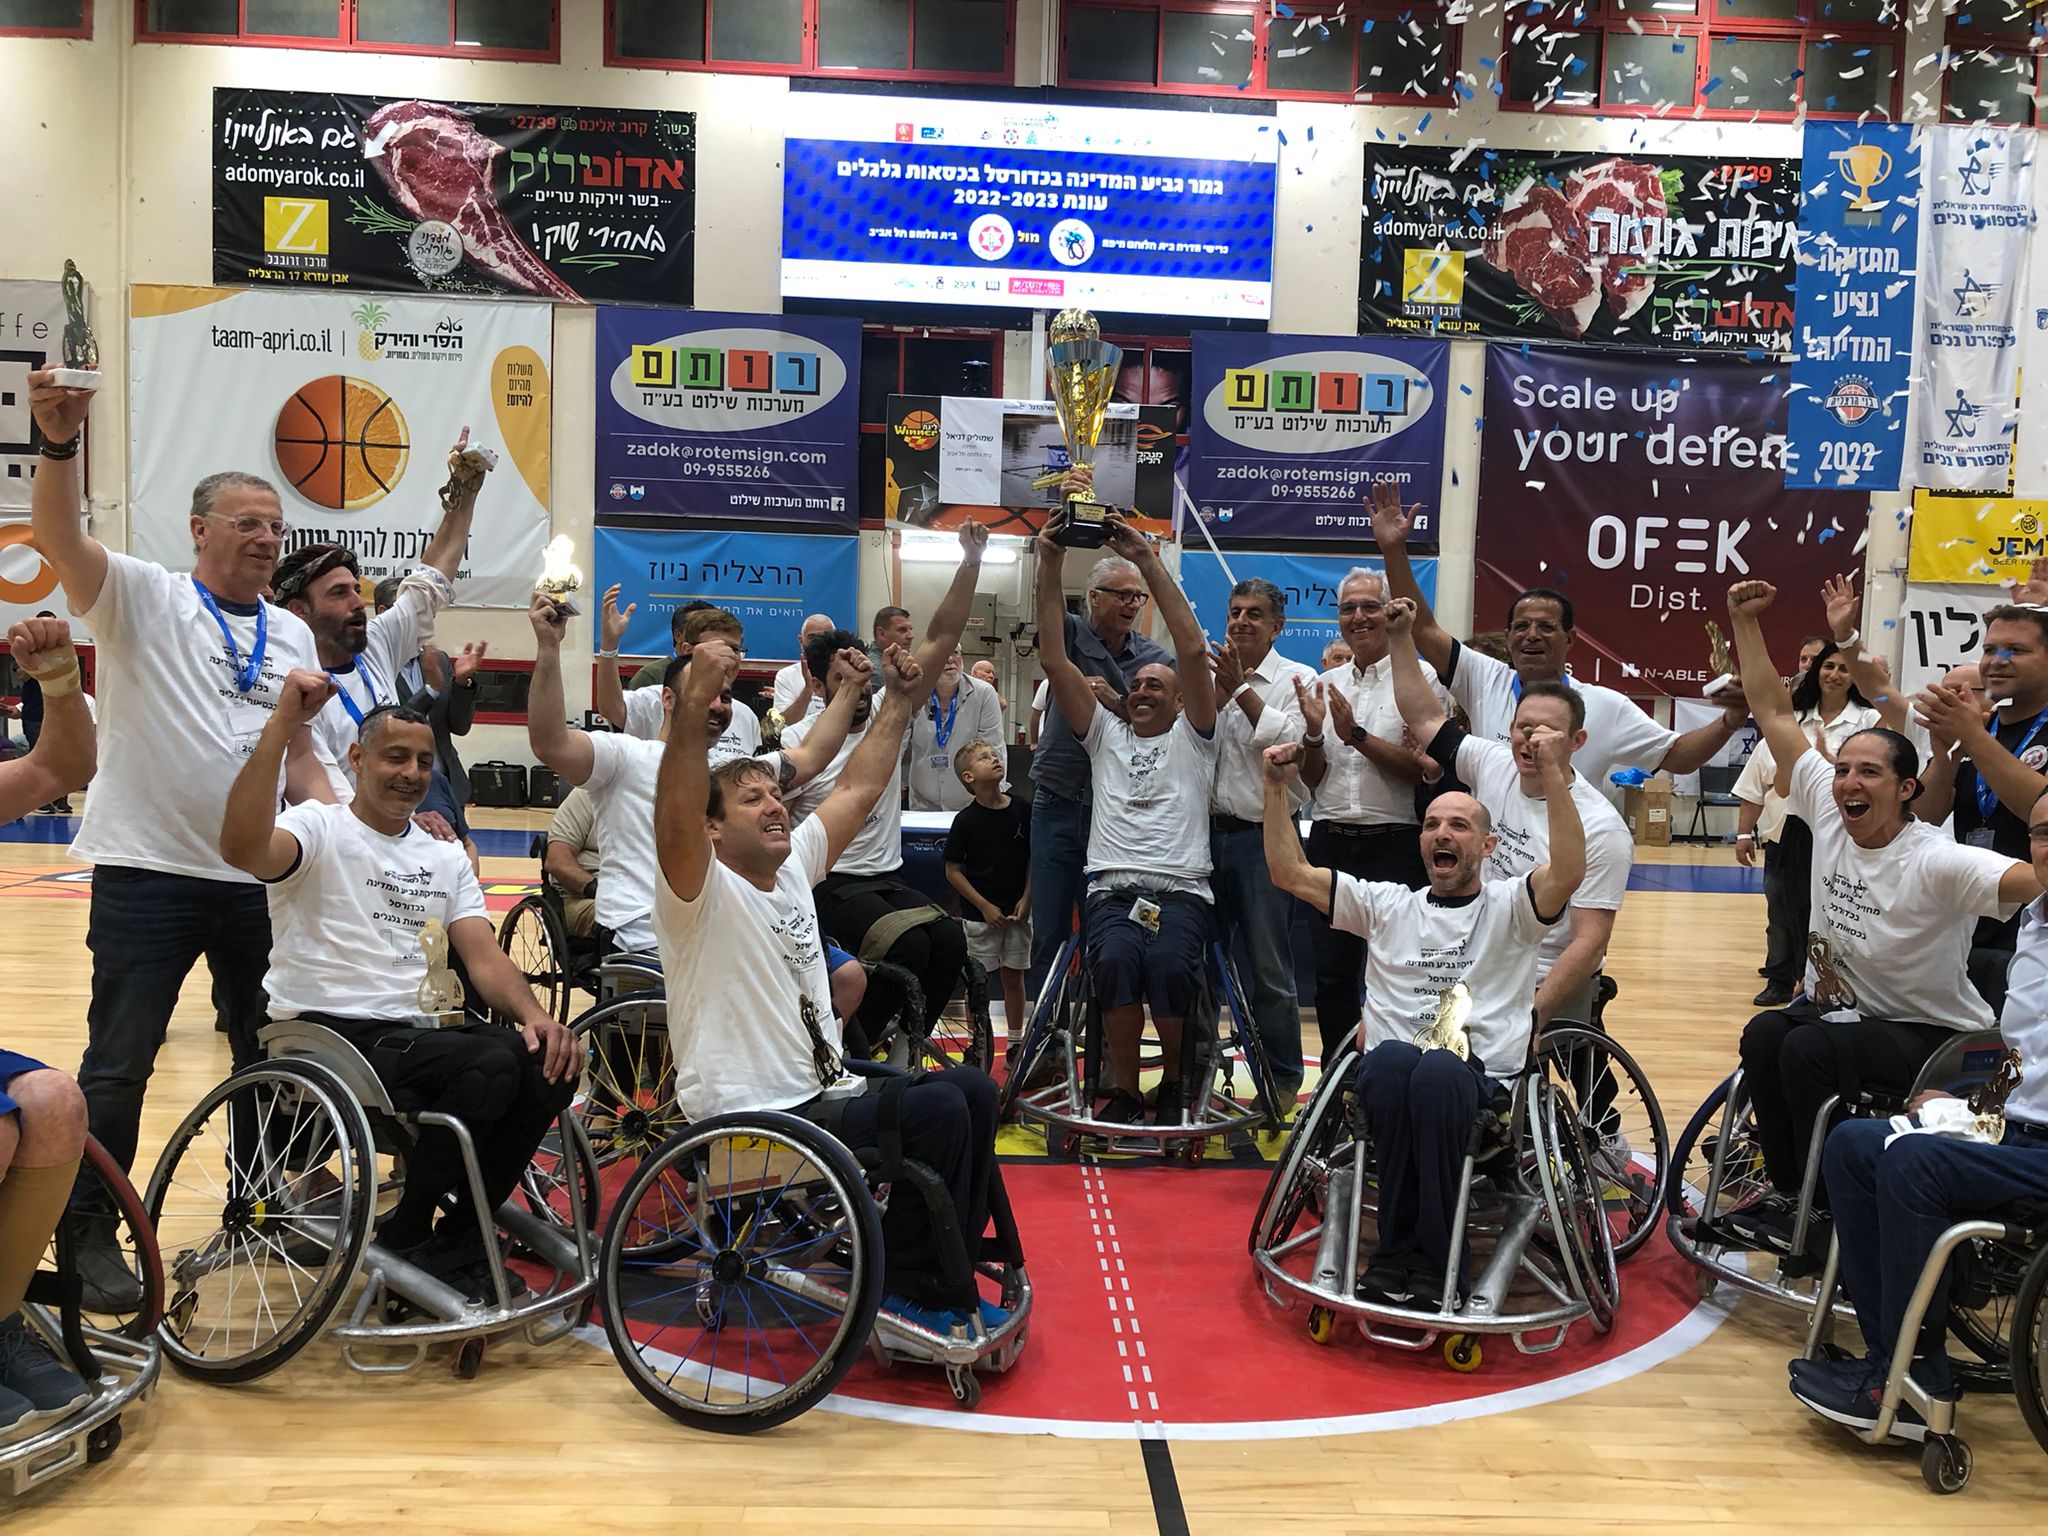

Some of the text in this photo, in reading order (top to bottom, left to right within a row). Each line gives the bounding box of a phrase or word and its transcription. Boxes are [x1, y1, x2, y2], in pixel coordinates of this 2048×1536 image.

[224, 108, 356, 151] גם באונליין!
[580, 118, 648, 137] קרוב אליכם
[664, 123, 690, 136] כשר
[225, 163, 365, 188] adomyarok.co.il
[837, 158, 1223, 195] גמר גביע המדינה בכדורסל בכסאות גלגלים
[579, 192, 623, 209] וירקות
[953, 188, 1108, 211] עונת 2022-2023
[276, 201, 318, 251] Z
[1933, 213, 1966, 225] נכים
[532, 221, 667, 261] במחירי שוק!
[1017, 230, 1040, 243] מול
[267, 254, 327, 267] מרכז זרובבל
[248, 268, 349, 284] אבן עזרא 17 הרצליה
[1833, 291, 1879, 318] גביע
[1386, 317, 1420, 328] הרצליה
[1438, 320, 1462, 330] עזרא
[1464, 321, 1480, 332] אבן
[211, 325, 333, 354] taam-apri.co.il
[374, 332, 463, 350] הפרי והירק
[1930, 334, 1962, 347] נכים
[507, 362, 533, 376] משלוח
[642, 351, 806, 386] רותם
[509, 379, 531, 391] מהיום
[1236, 374, 1393, 406] רותם
[507, 393, 533, 407] להיום!
[692, 394, 738, 410] שילוט
[747, 396, 804, 413] מערכות
[1513, 374, 1678, 420] Scale up
[894, 424, 939, 437] Winner
[1283, 415, 1328, 431] שילוט
[1336, 418, 1391, 433] מערכות
[945, 432, 965, 441] דניאל
[626, 442, 827, 464] zadok@rotemsign.com
[1513, 423, 1787, 471] your defen
[1924, 441, 1958, 452] ישראלית
[1136, 451, 1163, 459] מנהל
[1137, 457, 1161, 465] הליג
[1819, 441, 1876, 472] 2022
[1923, 452, 1953, 466] נכים
[683, 462, 770, 479] 09-9555266
[1217, 465, 1411, 484] zadok@rotemsign.com
[1271, 484, 1356, 499] 09-9555266
[730, 494, 830, 510] רותם מערכות שילוט
[1315, 514, 1373, 527] רכות שילוט
[1587, 514, 1751, 575] OFEK
[1989, 536, 2048, 557] JEM
[649, 560, 803, 585] הרצליה ניוז
[1285, 584, 1340, 606] צליה
[1630, 584, 1708, 611] Dist.
[649, 603, 803, 618] רואים את חרת
[1910, 607, 1980, 667] לין
[261, 671, 285, 682] חזיקת
[1644, 667, 1708, 683] N-ABLE
[1512, 849, 1535, 863] מחזיקת
[366, 878, 447, 899] מחזיקת גביע המדינה
[389, 898, 425, 912] בכדורסל
[373, 912, 428, 928] סאות גלגלים
[1405, 960, 1434, 968] המדינה
[1436, 961, 1456, 969] גביע
[1428, 975, 1459, 984] כדורסל
